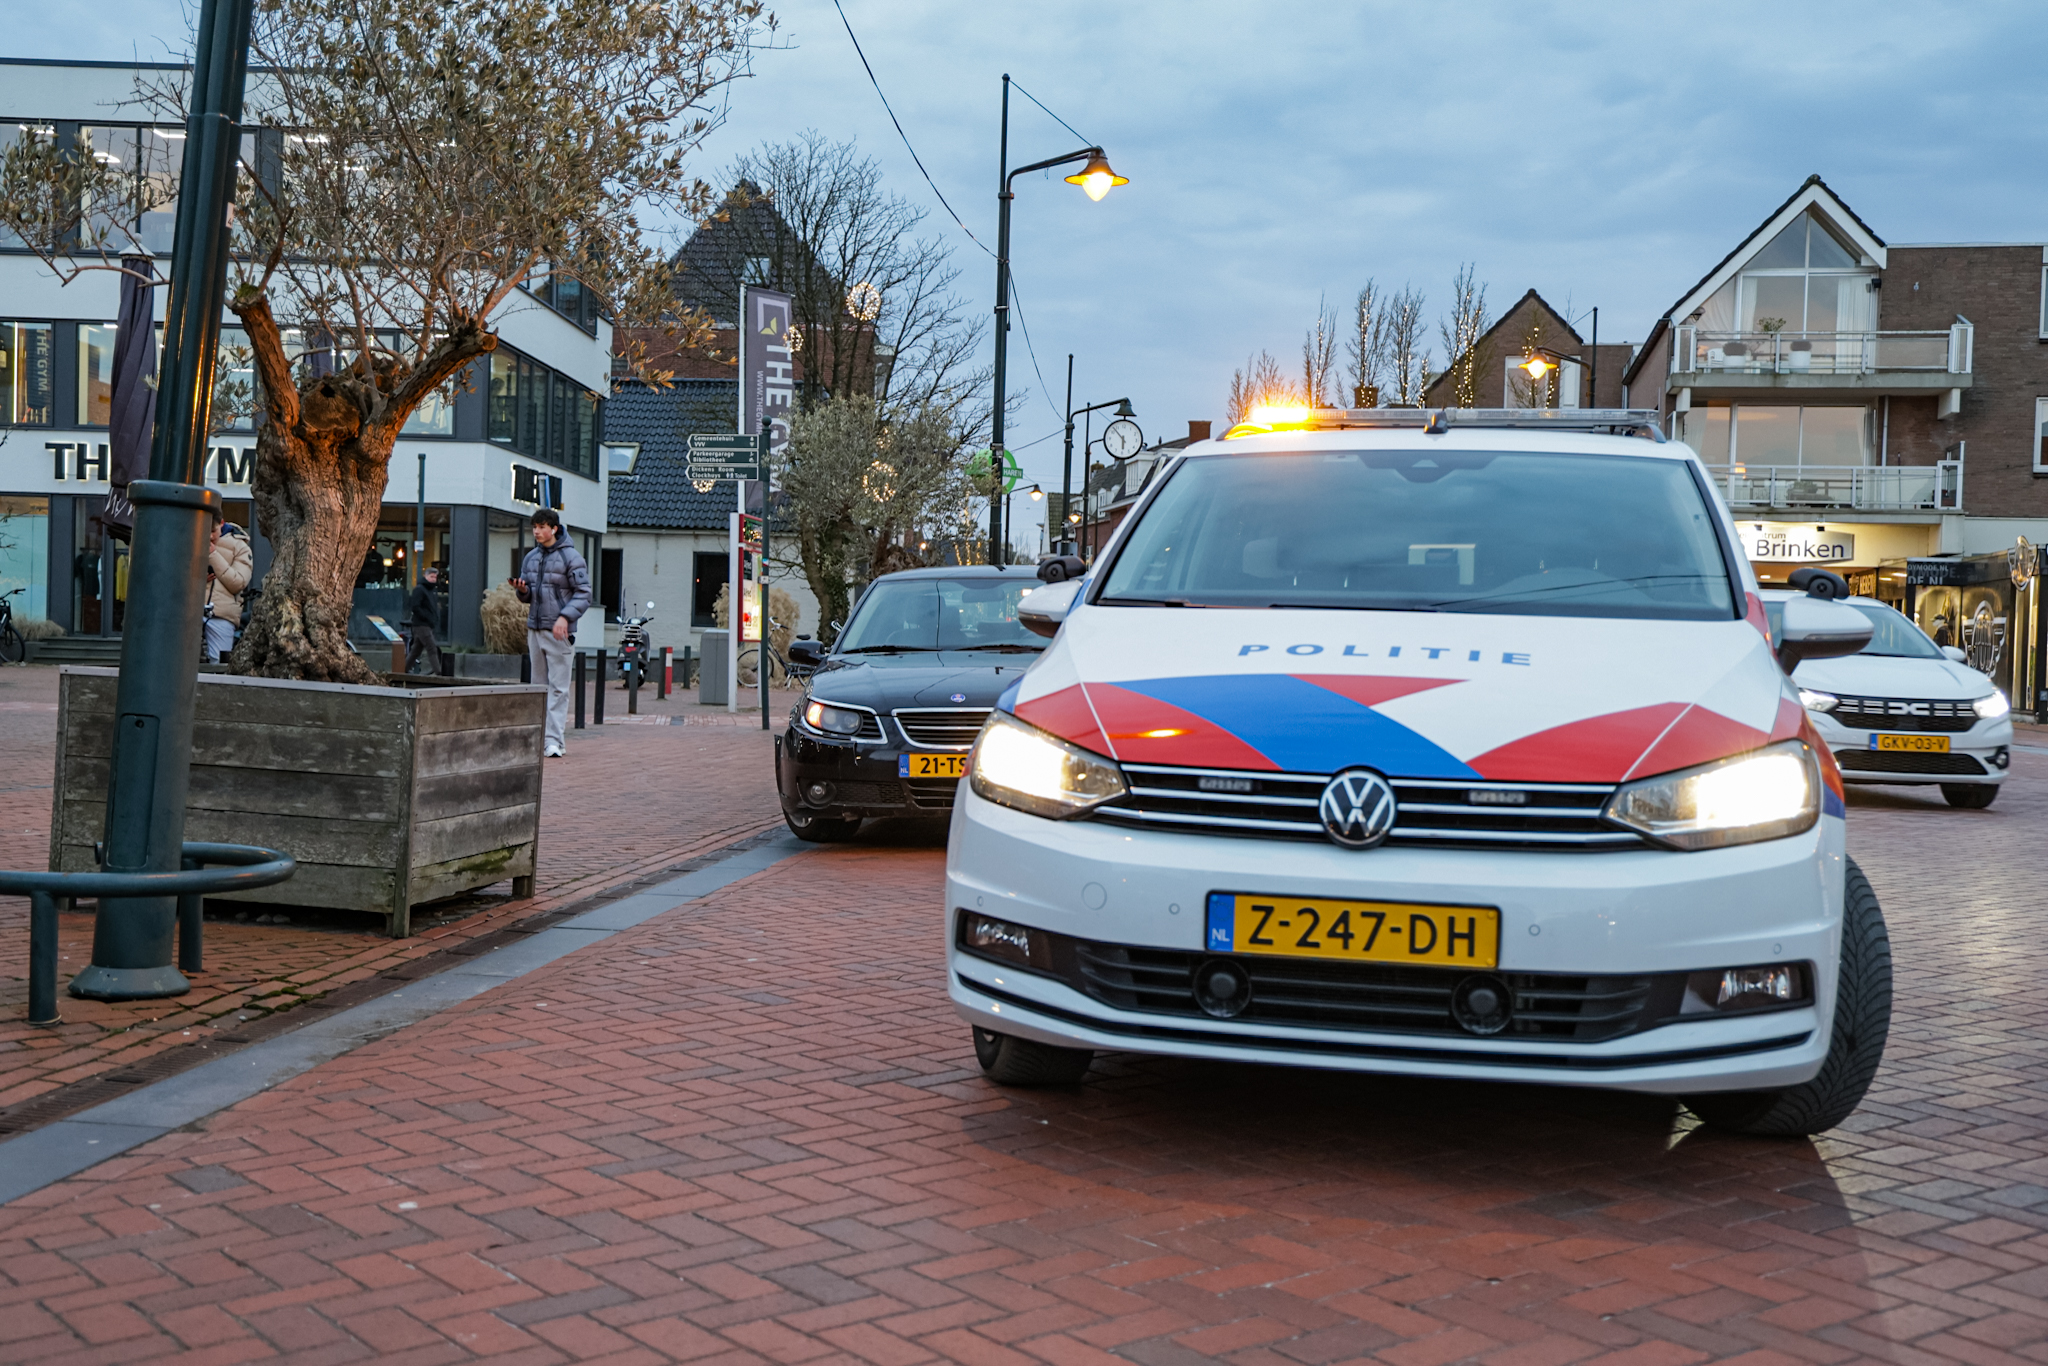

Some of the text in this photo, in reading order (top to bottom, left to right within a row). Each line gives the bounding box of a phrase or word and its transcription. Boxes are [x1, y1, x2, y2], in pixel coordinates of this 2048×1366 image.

[766, 340, 793, 408] THE
[45, 442, 109, 480] TH
[1003, 469, 1022, 477] HAREN
[1756, 539, 1844, 557] Brinken
[1237, 644, 1531, 667] POLITIE
[1882, 737, 1946, 750] GKV-03-V
[920, 757, 967, 774] 21-TS
[1211, 929, 1231, 942] NL
[1248, 905, 1477, 957] Z-247-DH
